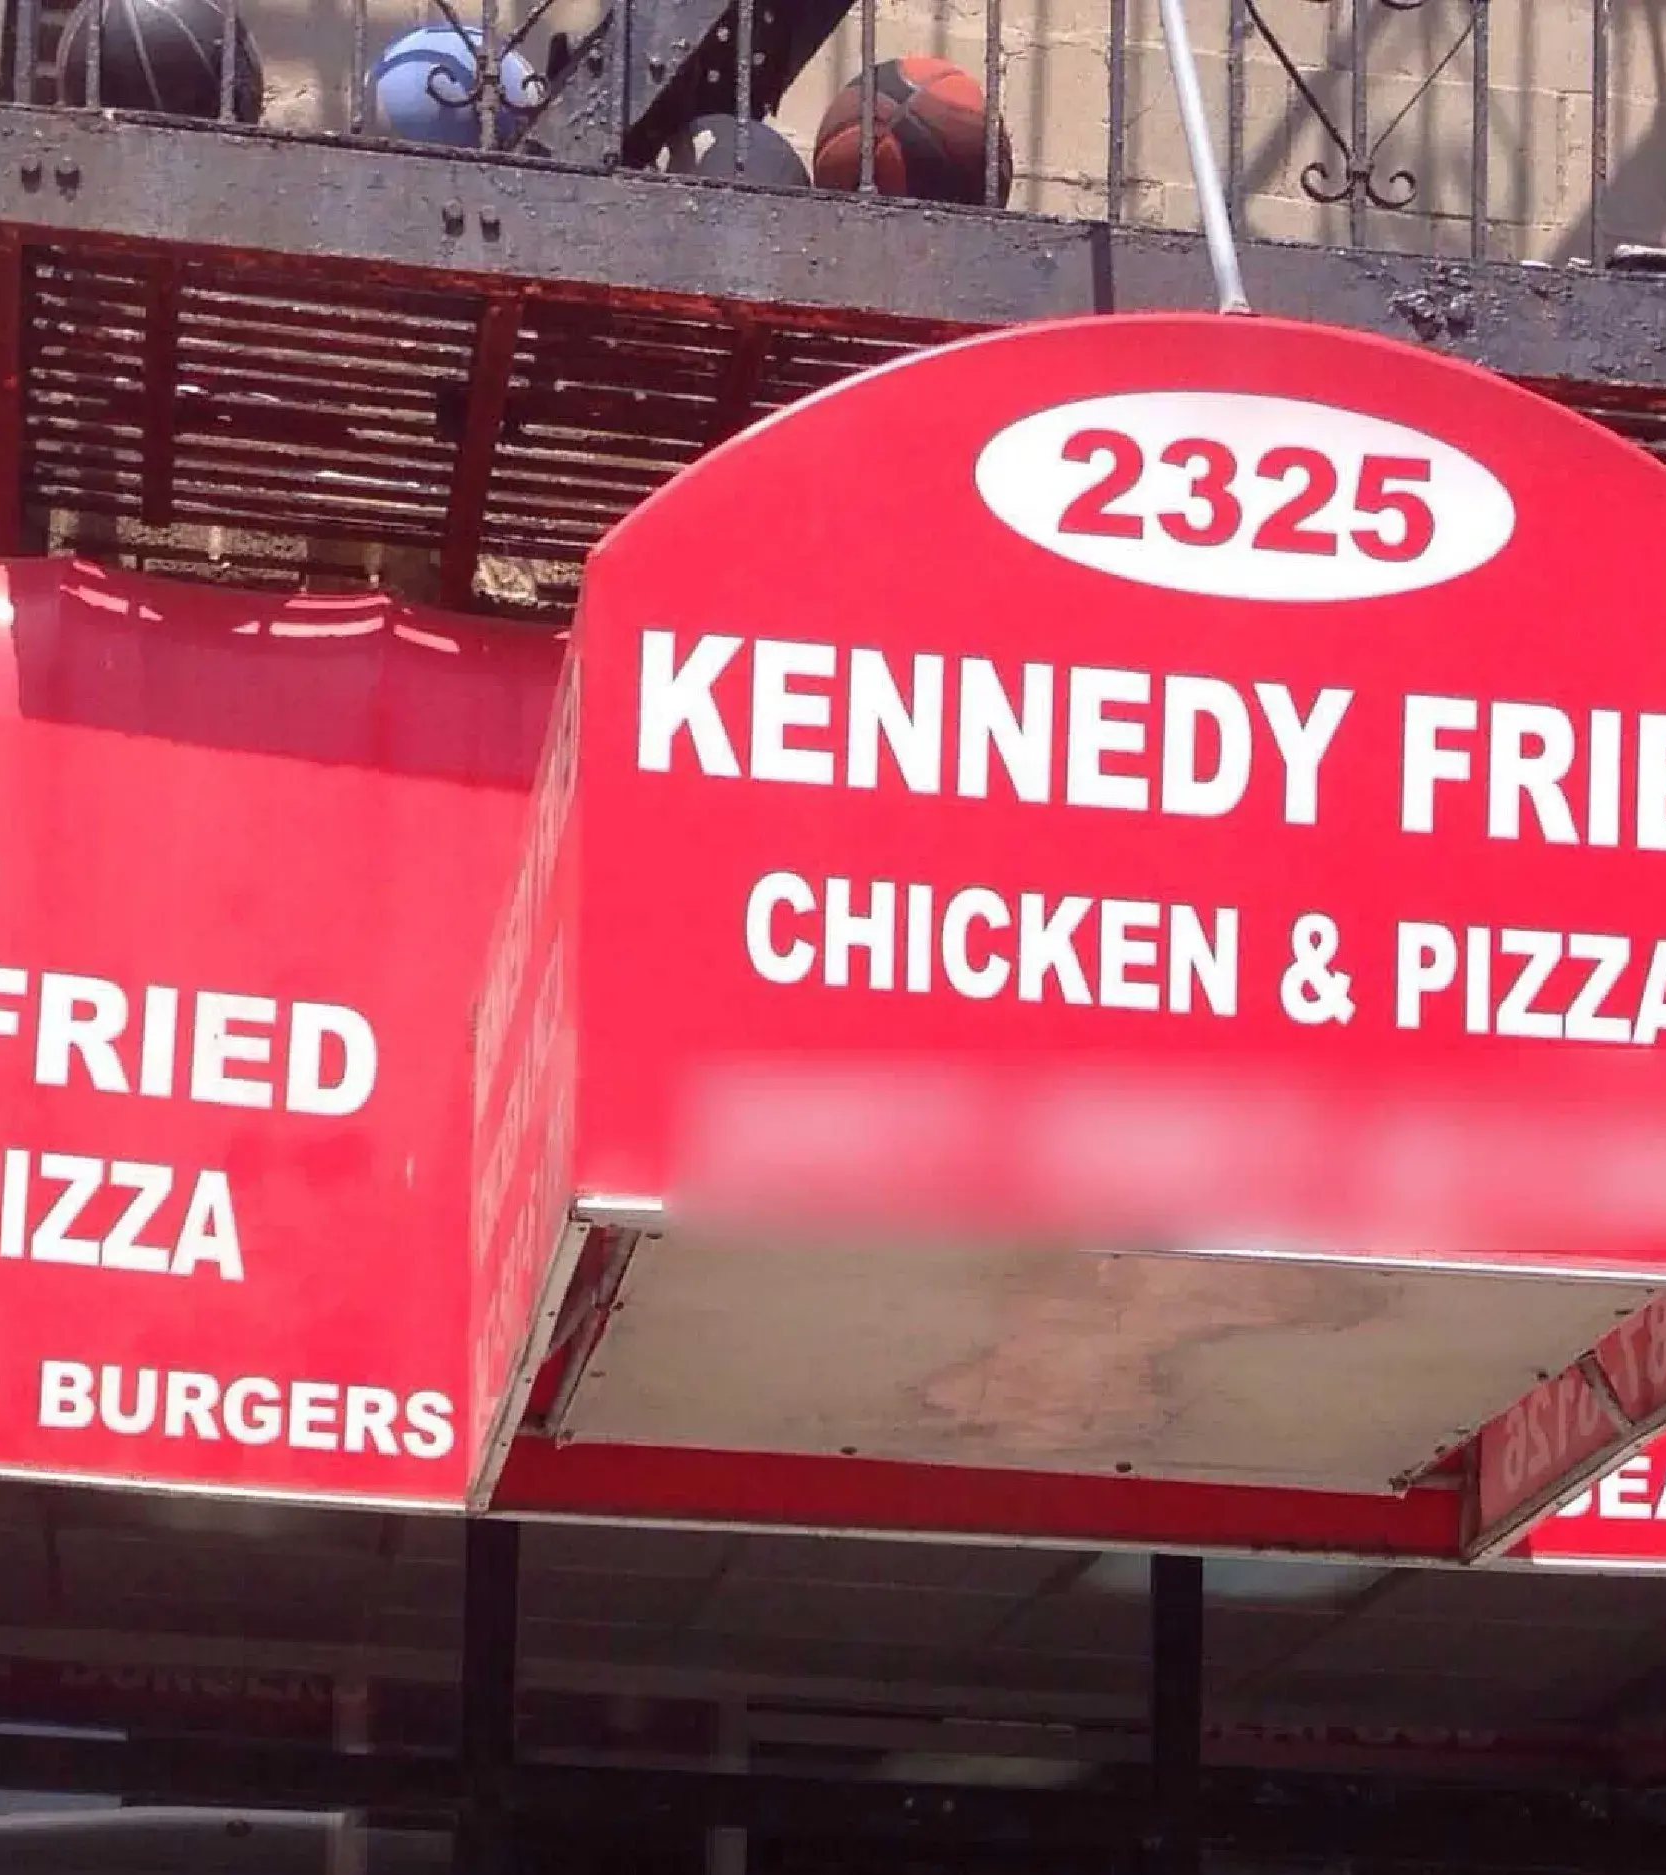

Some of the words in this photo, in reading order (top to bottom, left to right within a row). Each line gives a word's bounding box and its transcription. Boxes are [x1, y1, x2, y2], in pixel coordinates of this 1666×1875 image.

[1057, 428, 1436, 562] 2325
[638, 631, 1353, 824] KENNEDY
[747, 872, 1237, 1015] CHICKEN
[1281, 914, 1355, 1023] &
[40, 1361, 454, 1458] BURGERS
